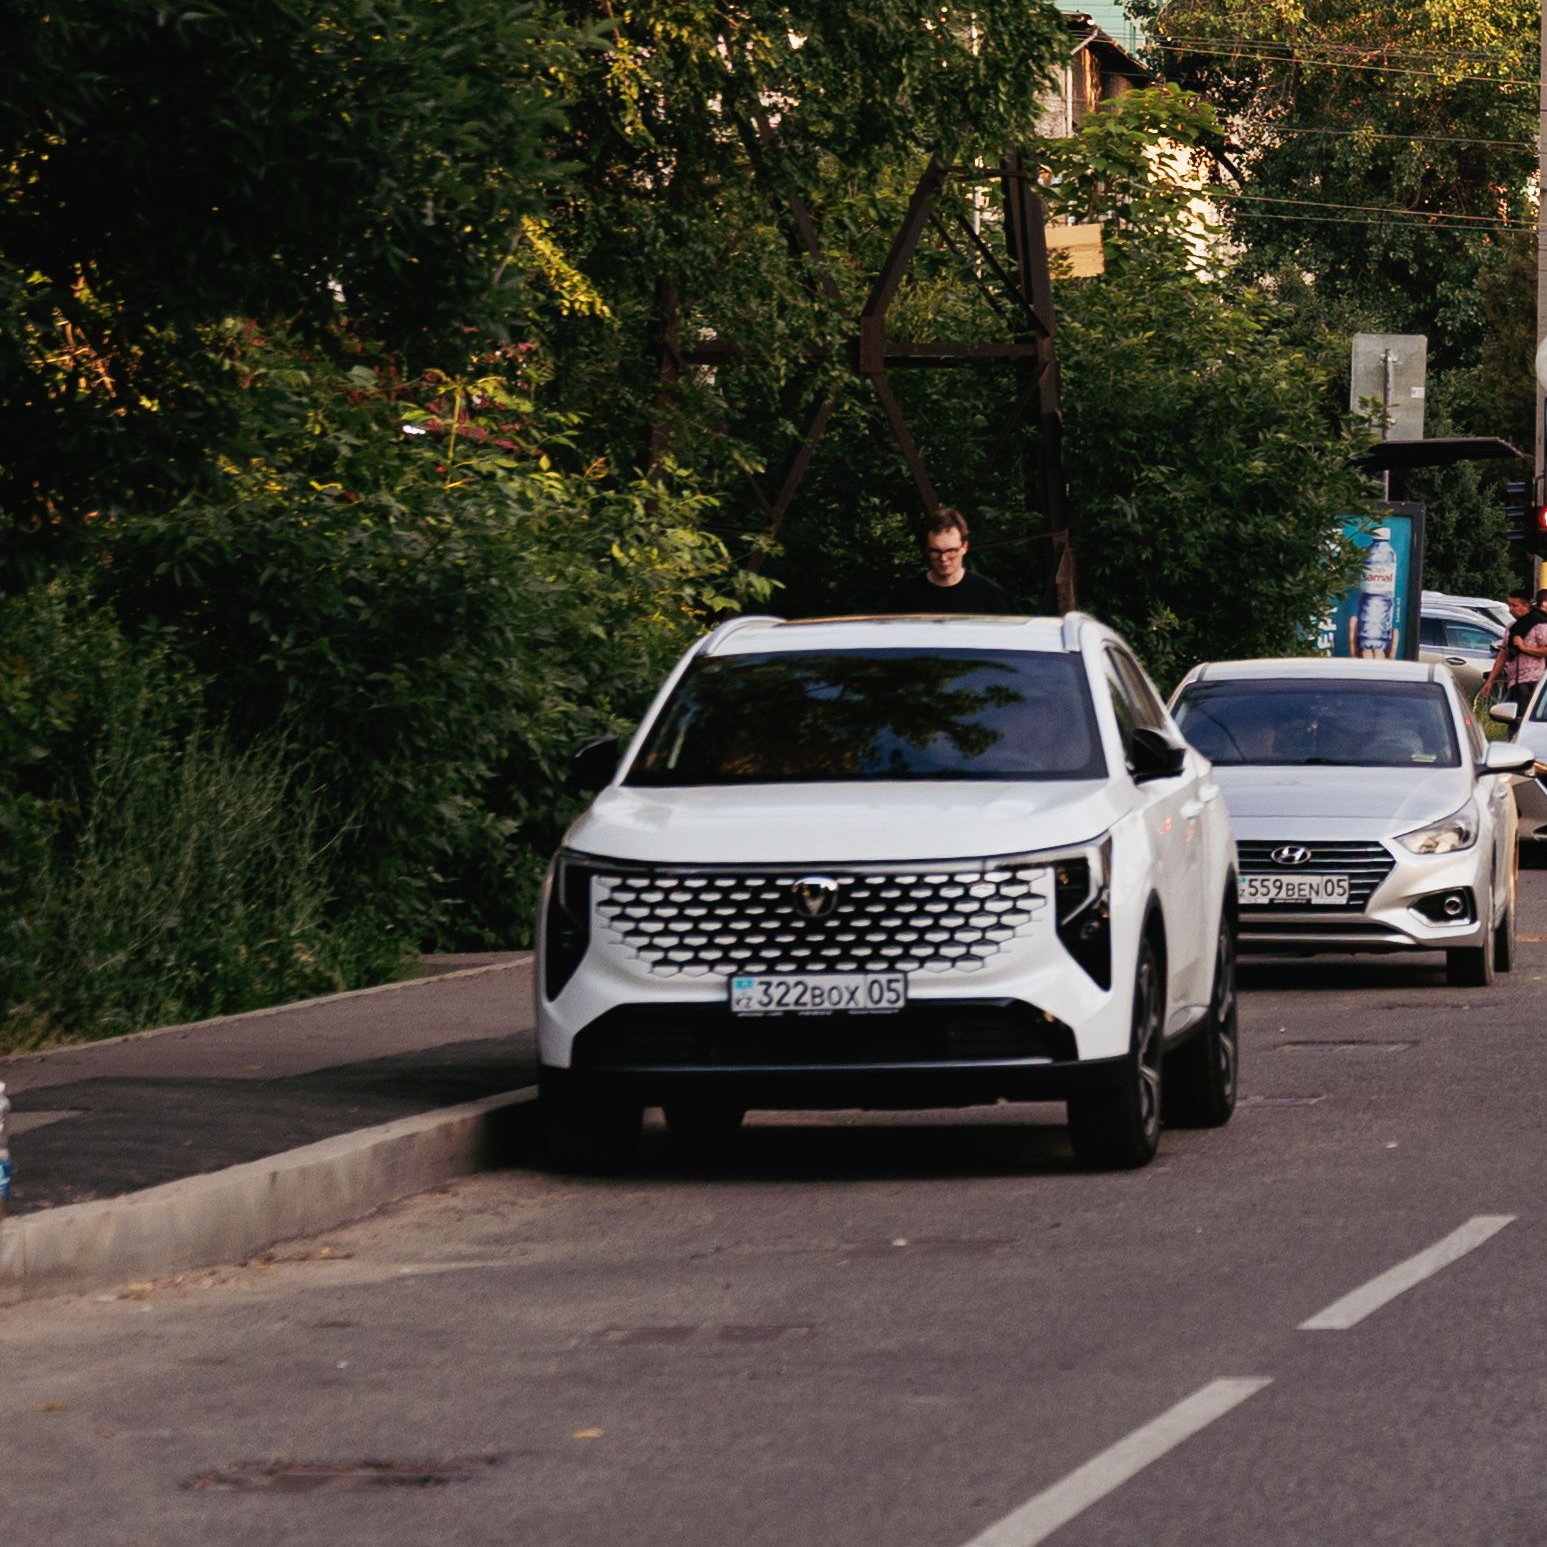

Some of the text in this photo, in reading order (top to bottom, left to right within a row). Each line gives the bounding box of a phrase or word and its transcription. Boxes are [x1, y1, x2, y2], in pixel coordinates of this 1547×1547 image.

[1248, 878, 1320, 897] 559BEN
[1324, 878, 1347, 897] 05
[757, 980, 859, 1007] 322BOX
[867, 979, 901, 1005] 05
